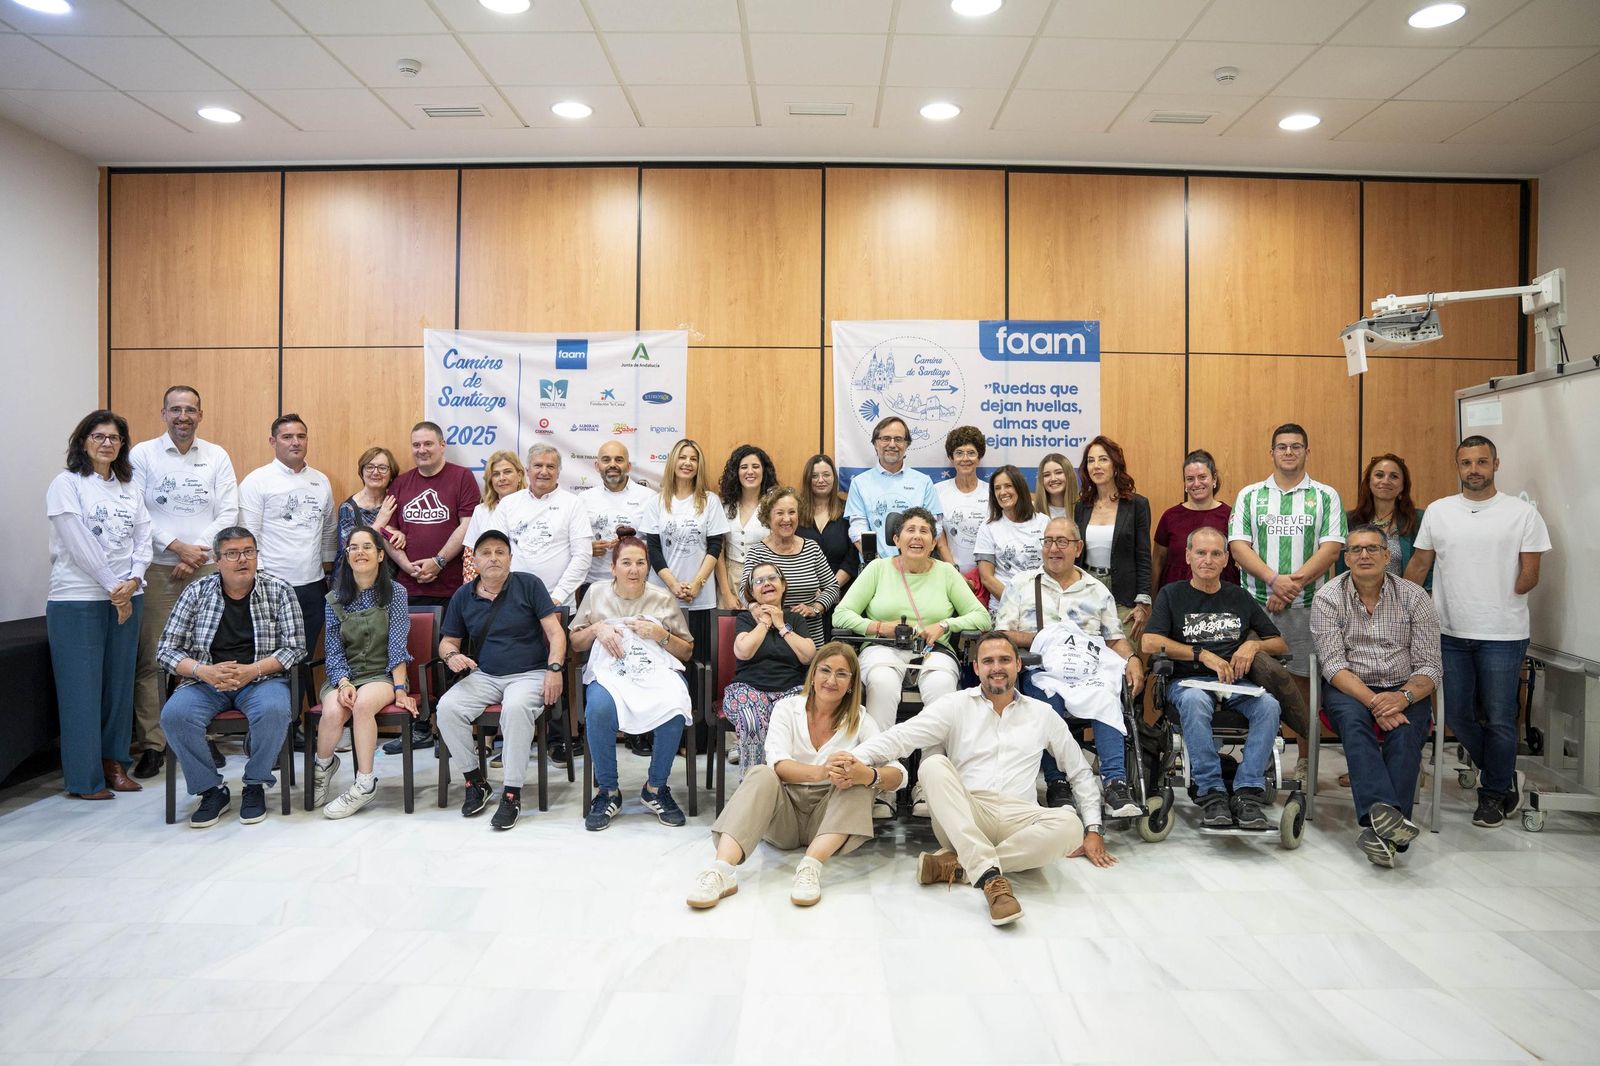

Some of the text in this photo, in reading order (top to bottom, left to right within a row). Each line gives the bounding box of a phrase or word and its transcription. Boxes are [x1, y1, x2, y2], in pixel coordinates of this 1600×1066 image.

[996, 326, 1086, 355] faam
[443, 348, 503, 370] Camino
[558, 350, 586, 359] faam
[914, 353, 943, 364] Camino
[918, 365, 951, 378] Santiago
[462, 371, 482, 388] de
[931, 379, 949, 387] 2025
[1050, 384, 1079, 397] que
[437, 385, 507, 413] Santiago
[980, 399, 1082, 414] dejan huellas,
[993, 417, 1071, 432] almas que
[446, 425, 498, 446] 2025
[405, 509, 445, 519] adidas
[1267, 525, 1304, 535] GREEN
